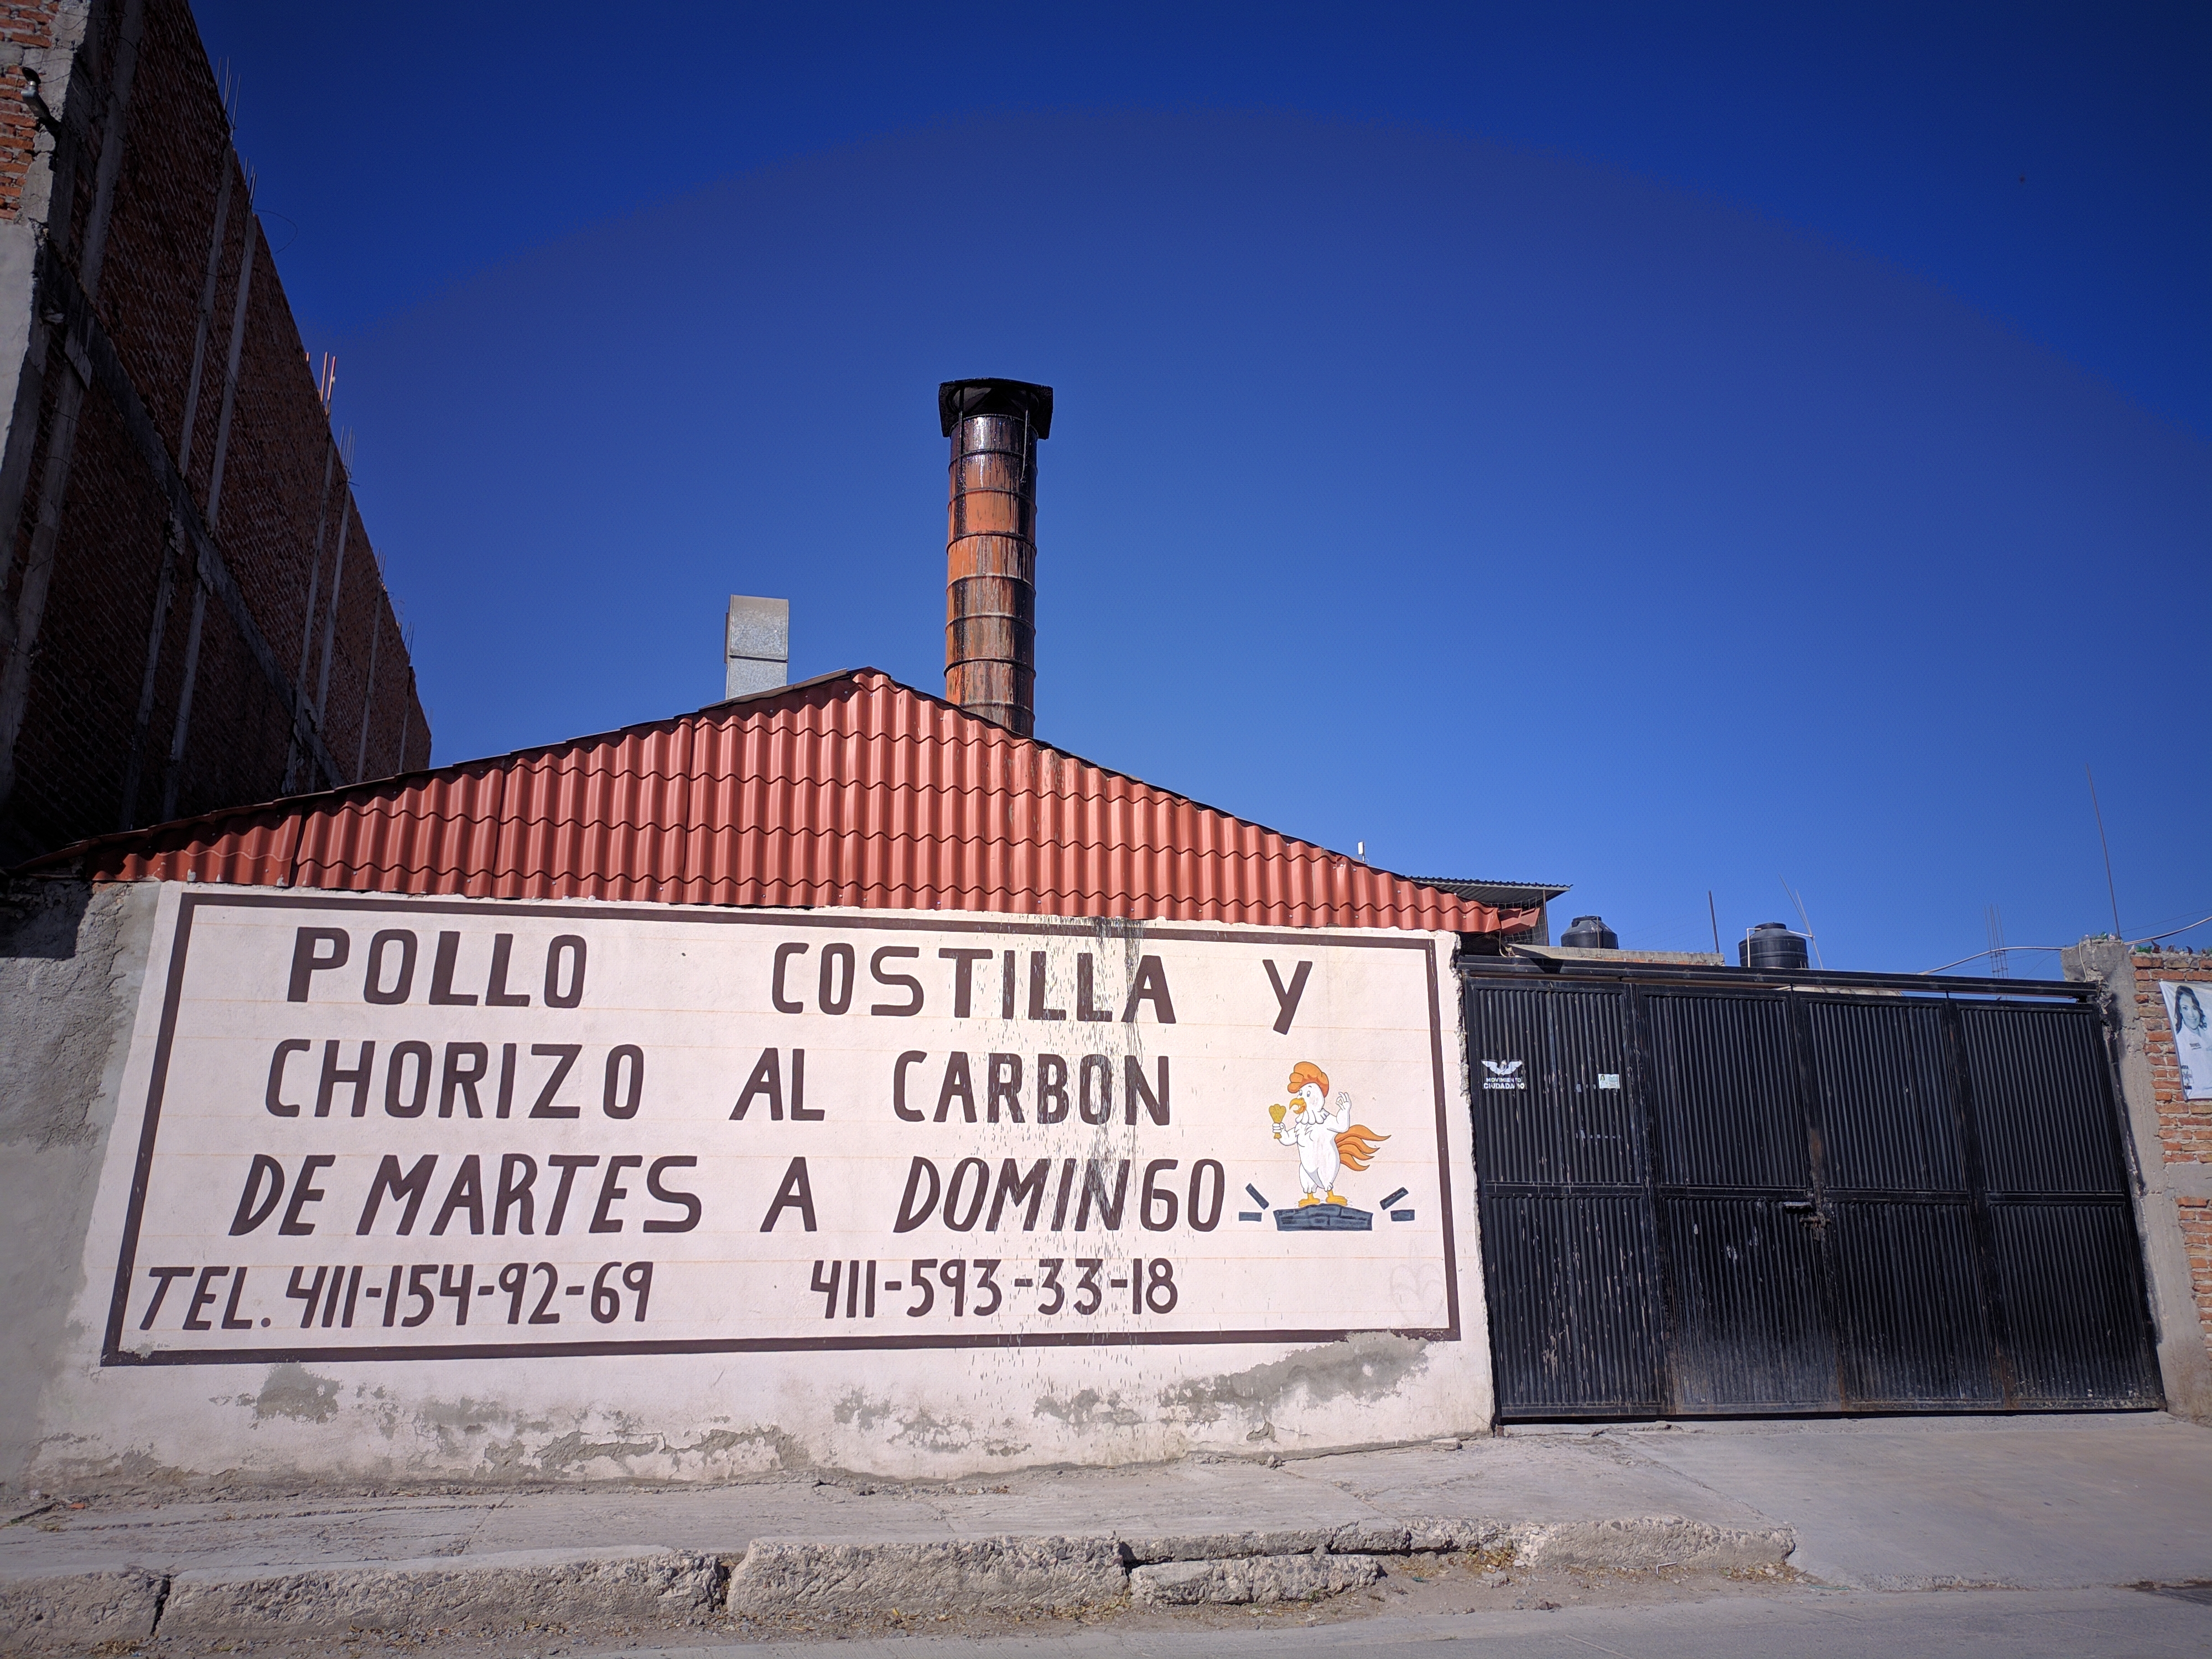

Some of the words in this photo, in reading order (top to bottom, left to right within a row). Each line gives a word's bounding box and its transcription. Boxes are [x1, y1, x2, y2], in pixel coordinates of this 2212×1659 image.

[287, 927, 586, 1008] POLLO
[772, 942, 1176, 1024] COSTILLA
[266, 1039, 643, 1119] CHORIZO
[729, 1048, 825, 1121] AL
[894, 1050, 1170, 1126] CARBON
[228, 1154, 336, 1236] DE
[356, 1153, 702, 1236] MARTES
[760, 1157, 817, 1232] A
[893, 1157, 1224, 1233] DOMINGO
[139, 1266, 271, 1330] TEL.
[286, 1262, 653, 1329] 411-154-92-69
[811, 1258, 1177, 1319] 411-593-33-18
